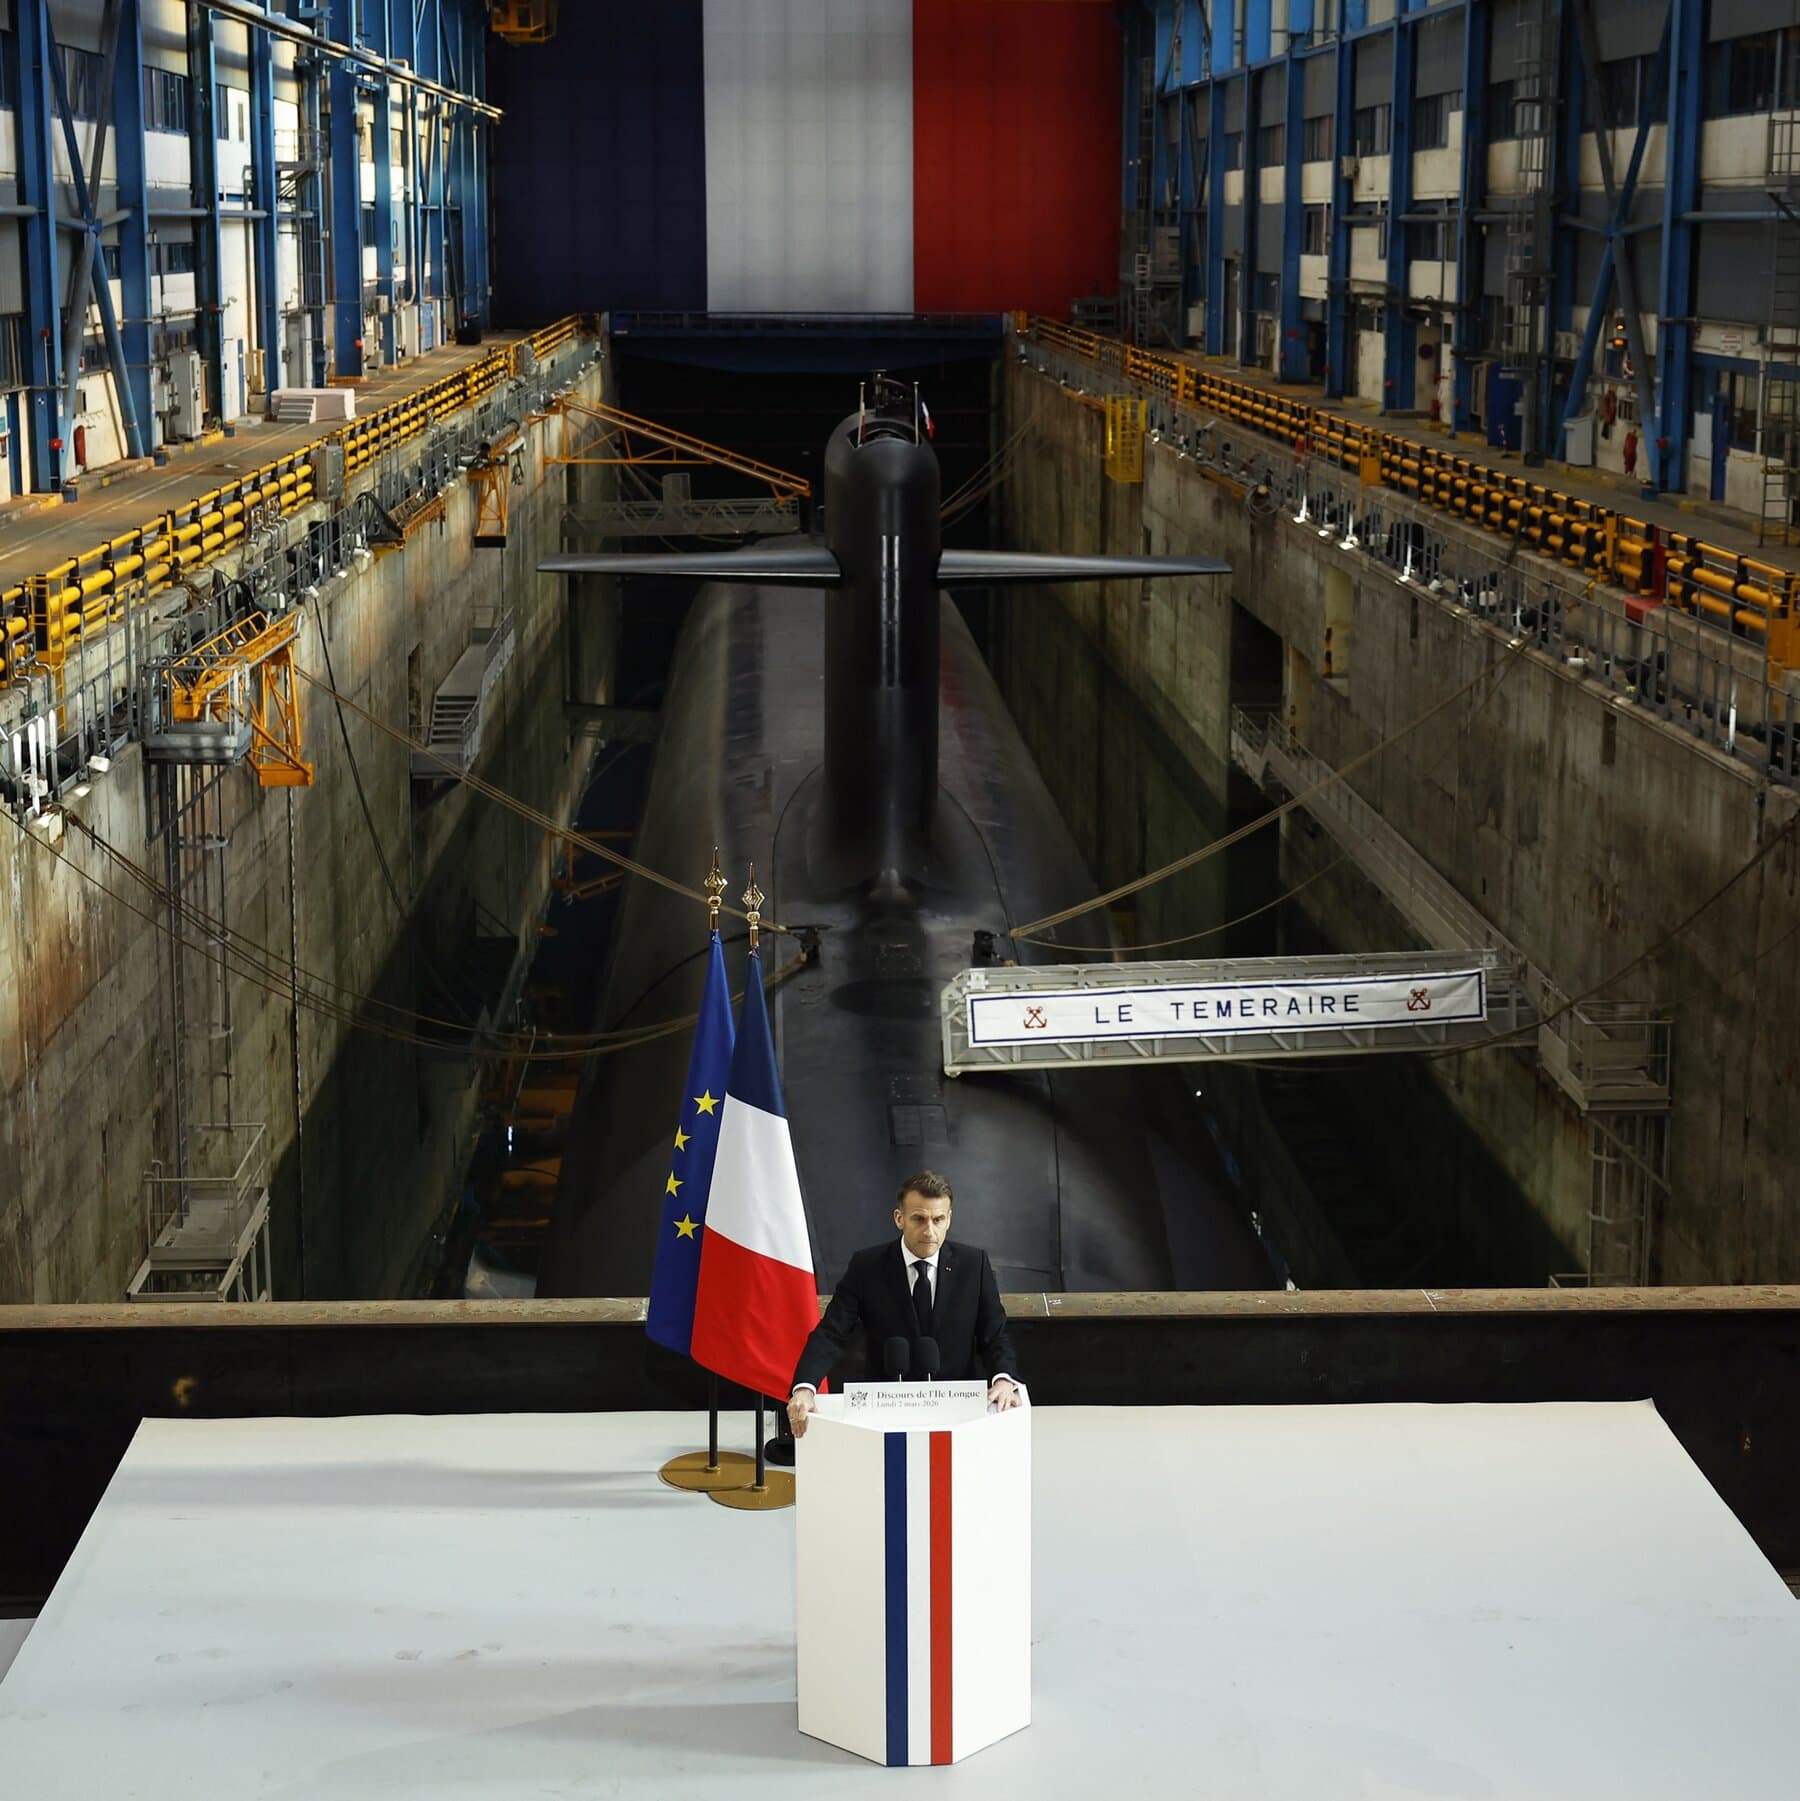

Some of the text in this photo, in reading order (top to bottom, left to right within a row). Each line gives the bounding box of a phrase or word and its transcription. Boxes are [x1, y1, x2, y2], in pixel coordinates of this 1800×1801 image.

[1095, 994, 1360, 1024] LE TEMERAIRE
[877, 1391, 915, 1399] Discours
[916, 1390, 927, 1399] de
[948, 1390, 981, 1399] Longue
